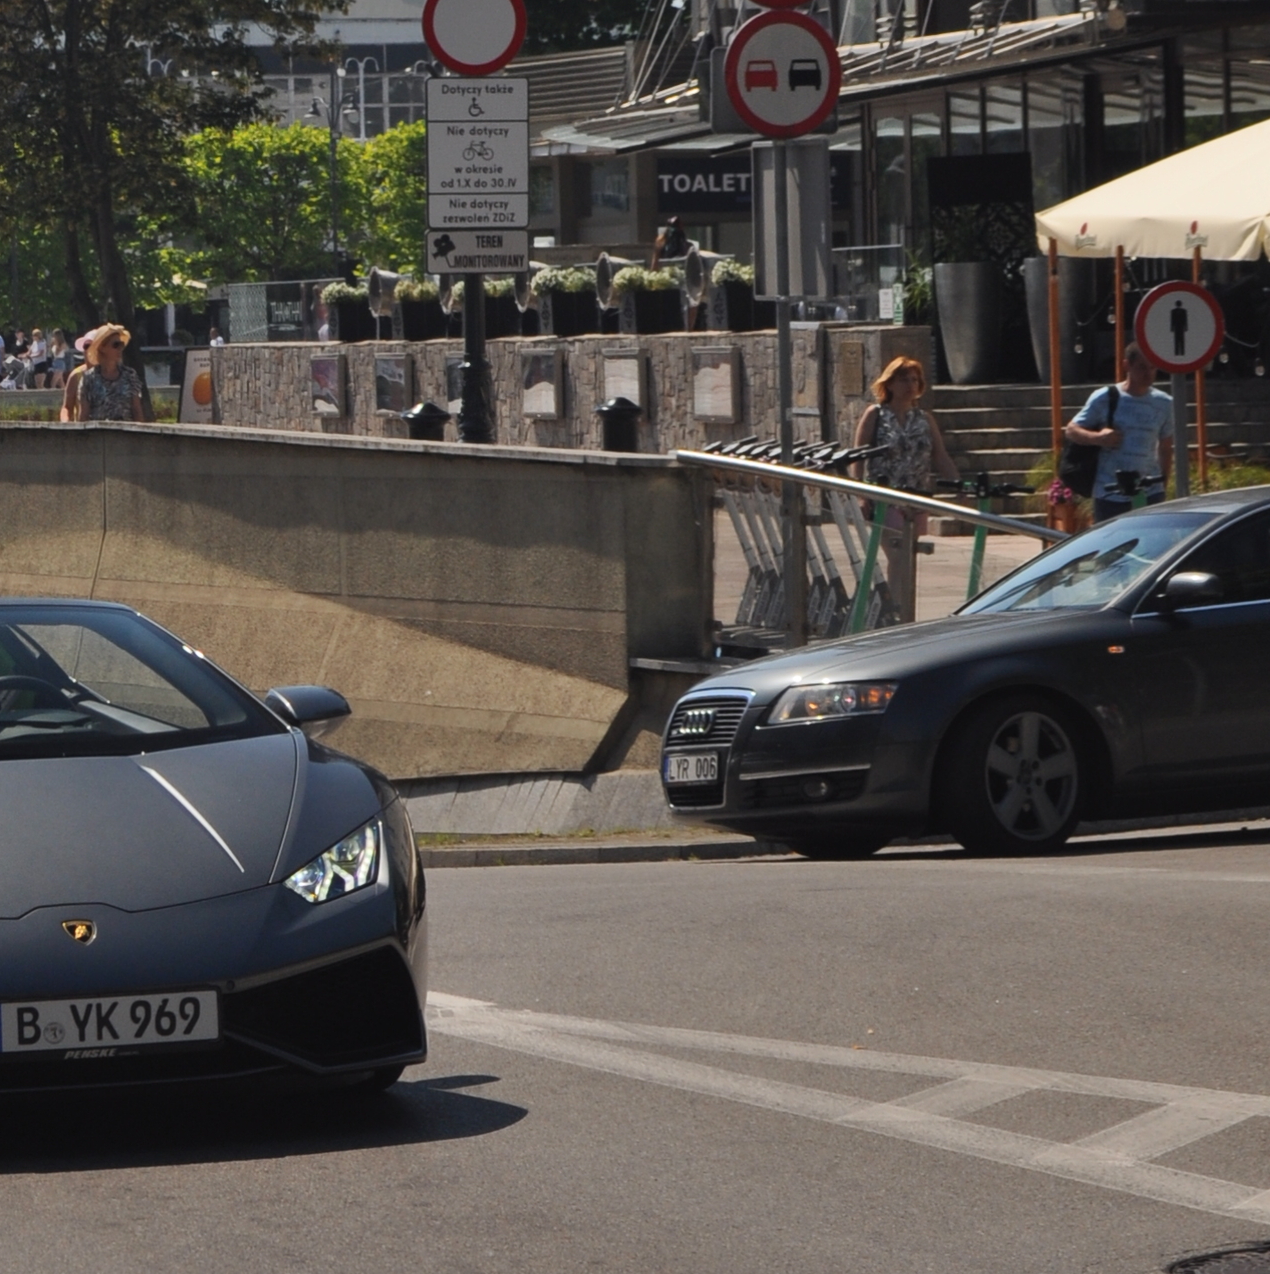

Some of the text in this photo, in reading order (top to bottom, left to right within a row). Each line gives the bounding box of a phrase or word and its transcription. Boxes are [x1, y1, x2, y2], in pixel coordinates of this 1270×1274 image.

[441, 84, 514, 97] Dotyczy także
[446, 126, 510, 138] Nie dotyczy
[454, 164, 503, 174] w okresie
[441, 178, 454, 188] od
[474, 178, 487, 188] do
[449, 198, 509, 211] Nie dotyczy
[442, 212, 516, 224] zezwoleń ZDiZ
[475, 235, 503, 248] TEREN
[454, 254, 525, 268] MONITOROWANY
[669, 756, 716, 780] LYR 006
[16, 996, 201, 1045] B YK 969
[64, 1048, 118, 1060] PENSKE
